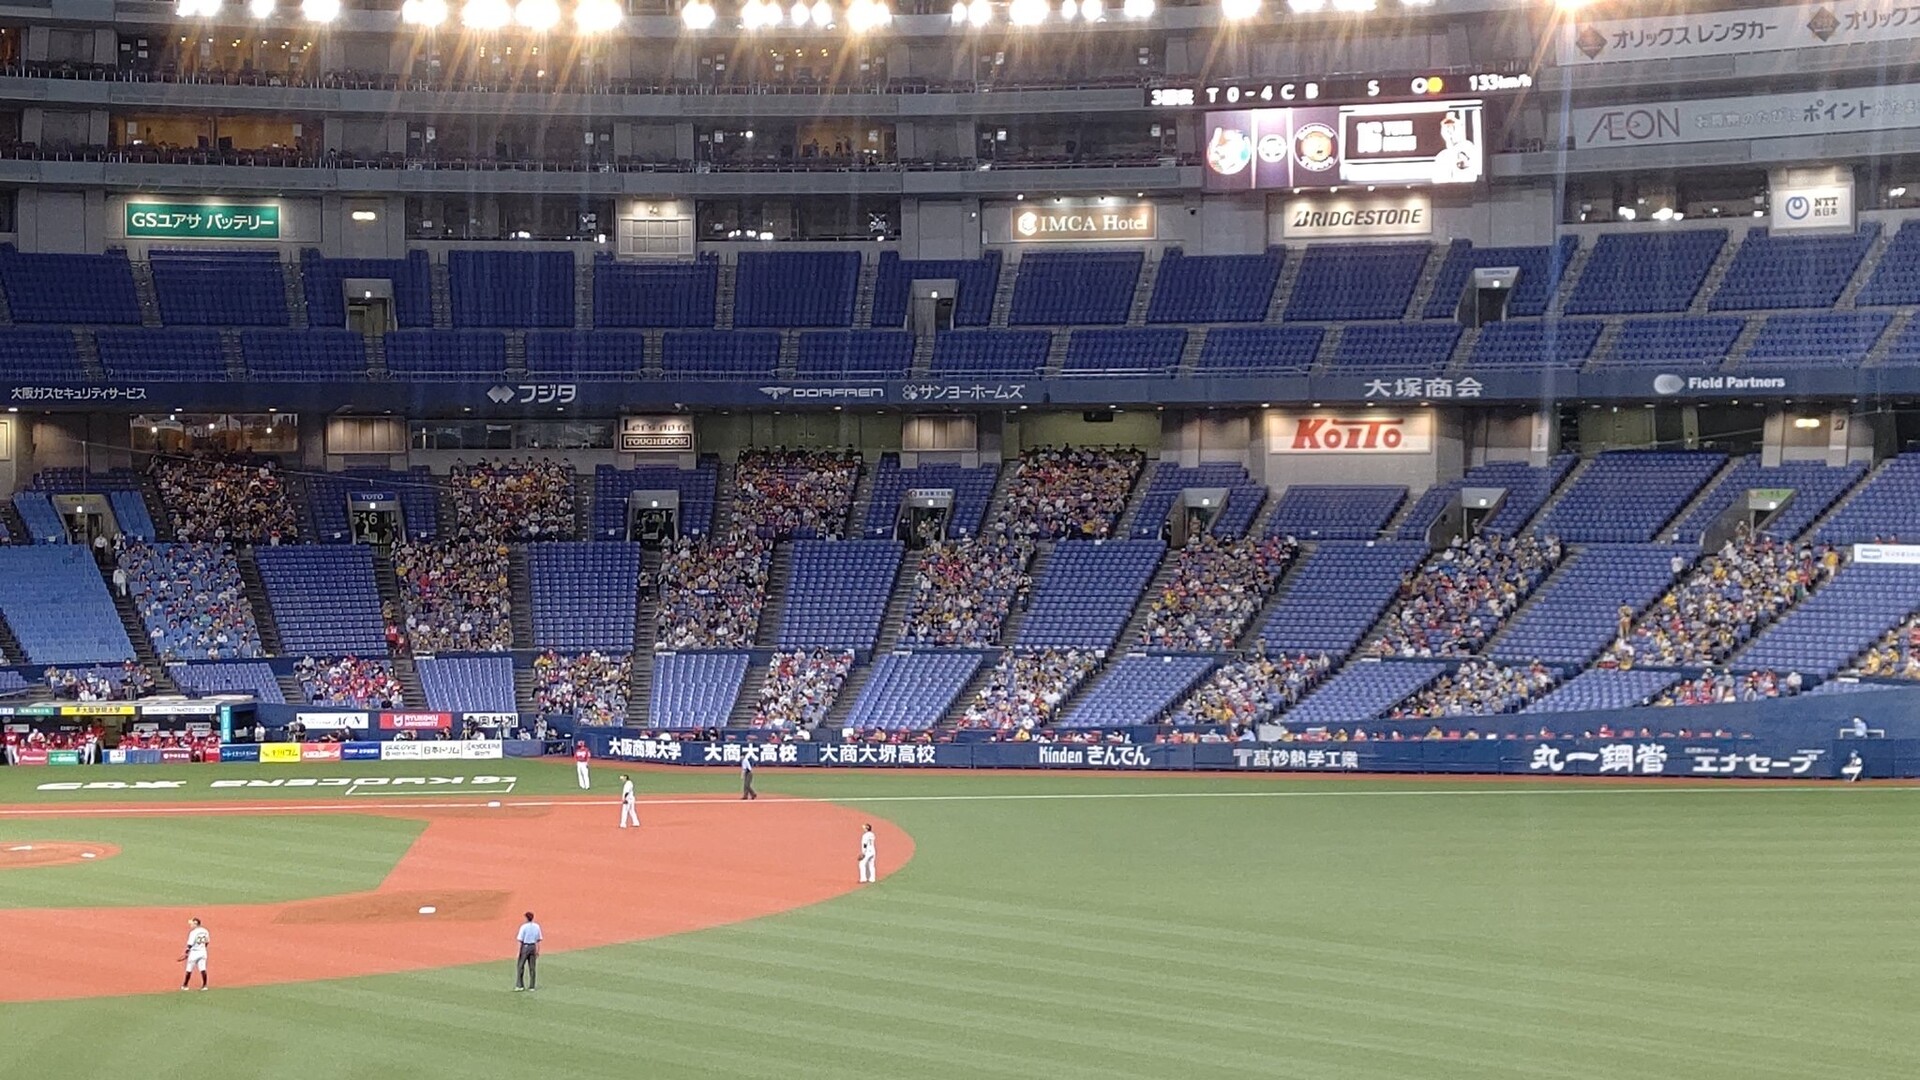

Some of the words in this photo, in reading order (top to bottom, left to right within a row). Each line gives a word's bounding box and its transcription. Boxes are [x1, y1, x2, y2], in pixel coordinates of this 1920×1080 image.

[1612, 26, 1691, 49] オリックス
[1698, 20, 1778, 43] レンタカー
[1814, 197, 1839, 207] NTT
[131, 212, 203, 230] GSユアサ
[206, 212, 275, 230] バッテリー
[1293, 208, 1423, 228] BRIDGESTONE
[1814, 207, 1838, 217] 西日本
[1040, 214, 1097, 232] IMCA
[1103, 213, 1149, 231] Hotel
[1364, 377, 1483, 398] 大塚商会
[1688, 377, 1724, 389] Field
[1727, 375, 1786, 389] Partners
[11, 387, 147, 400] 大阪ガスセキュリティサービス
[518, 384, 577, 404] フジタ
[918, 384, 1026, 401] サンヨーホームズ
[626, 438, 688, 446] TOUGHBOOK
[608, 737, 682, 762] 大阪商業大学
[704, 743, 797, 762] 大商大高校
[819, 743, 937, 764] 大商大堺高校
[1039, 745, 1083, 764] Kinden
[1087, 745, 1152, 766] きんでん
[1530, 742, 1668, 774] 丸一鋼管
[1692, 753, 1818, 773] エナセーブ
